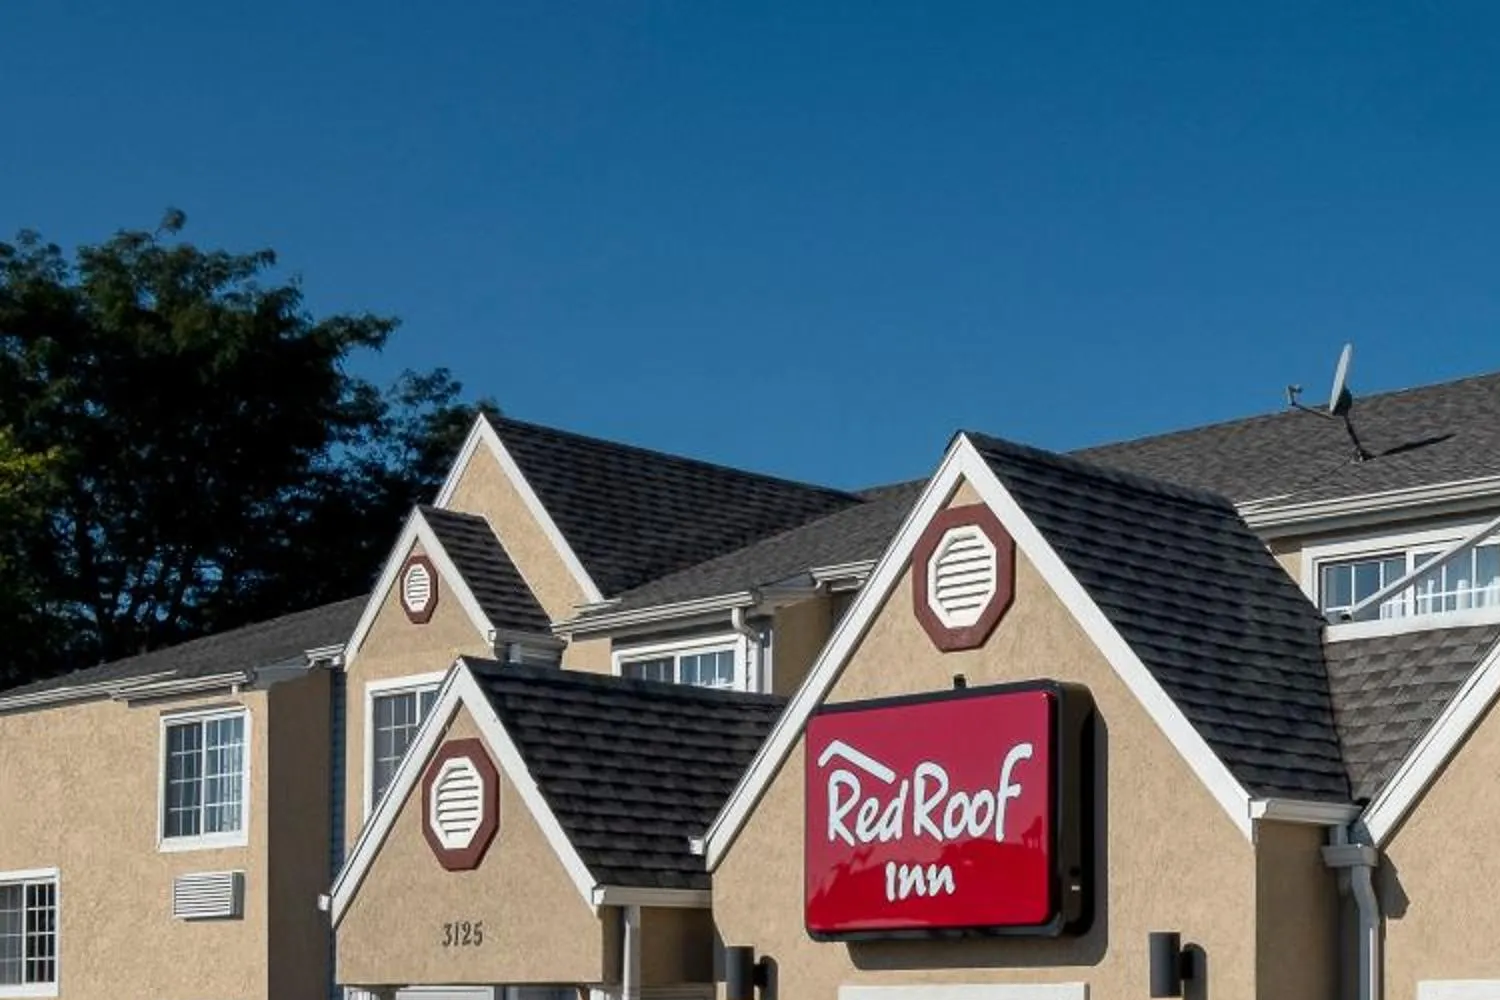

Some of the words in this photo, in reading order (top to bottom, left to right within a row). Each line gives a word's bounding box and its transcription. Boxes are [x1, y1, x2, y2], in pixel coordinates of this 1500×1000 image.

[828, 769, 908, 846] Red
[914, 743, 1033, 842] Roof
[885, 861, 956, 902] Inn
[442, 920, 483, 947] 3125
